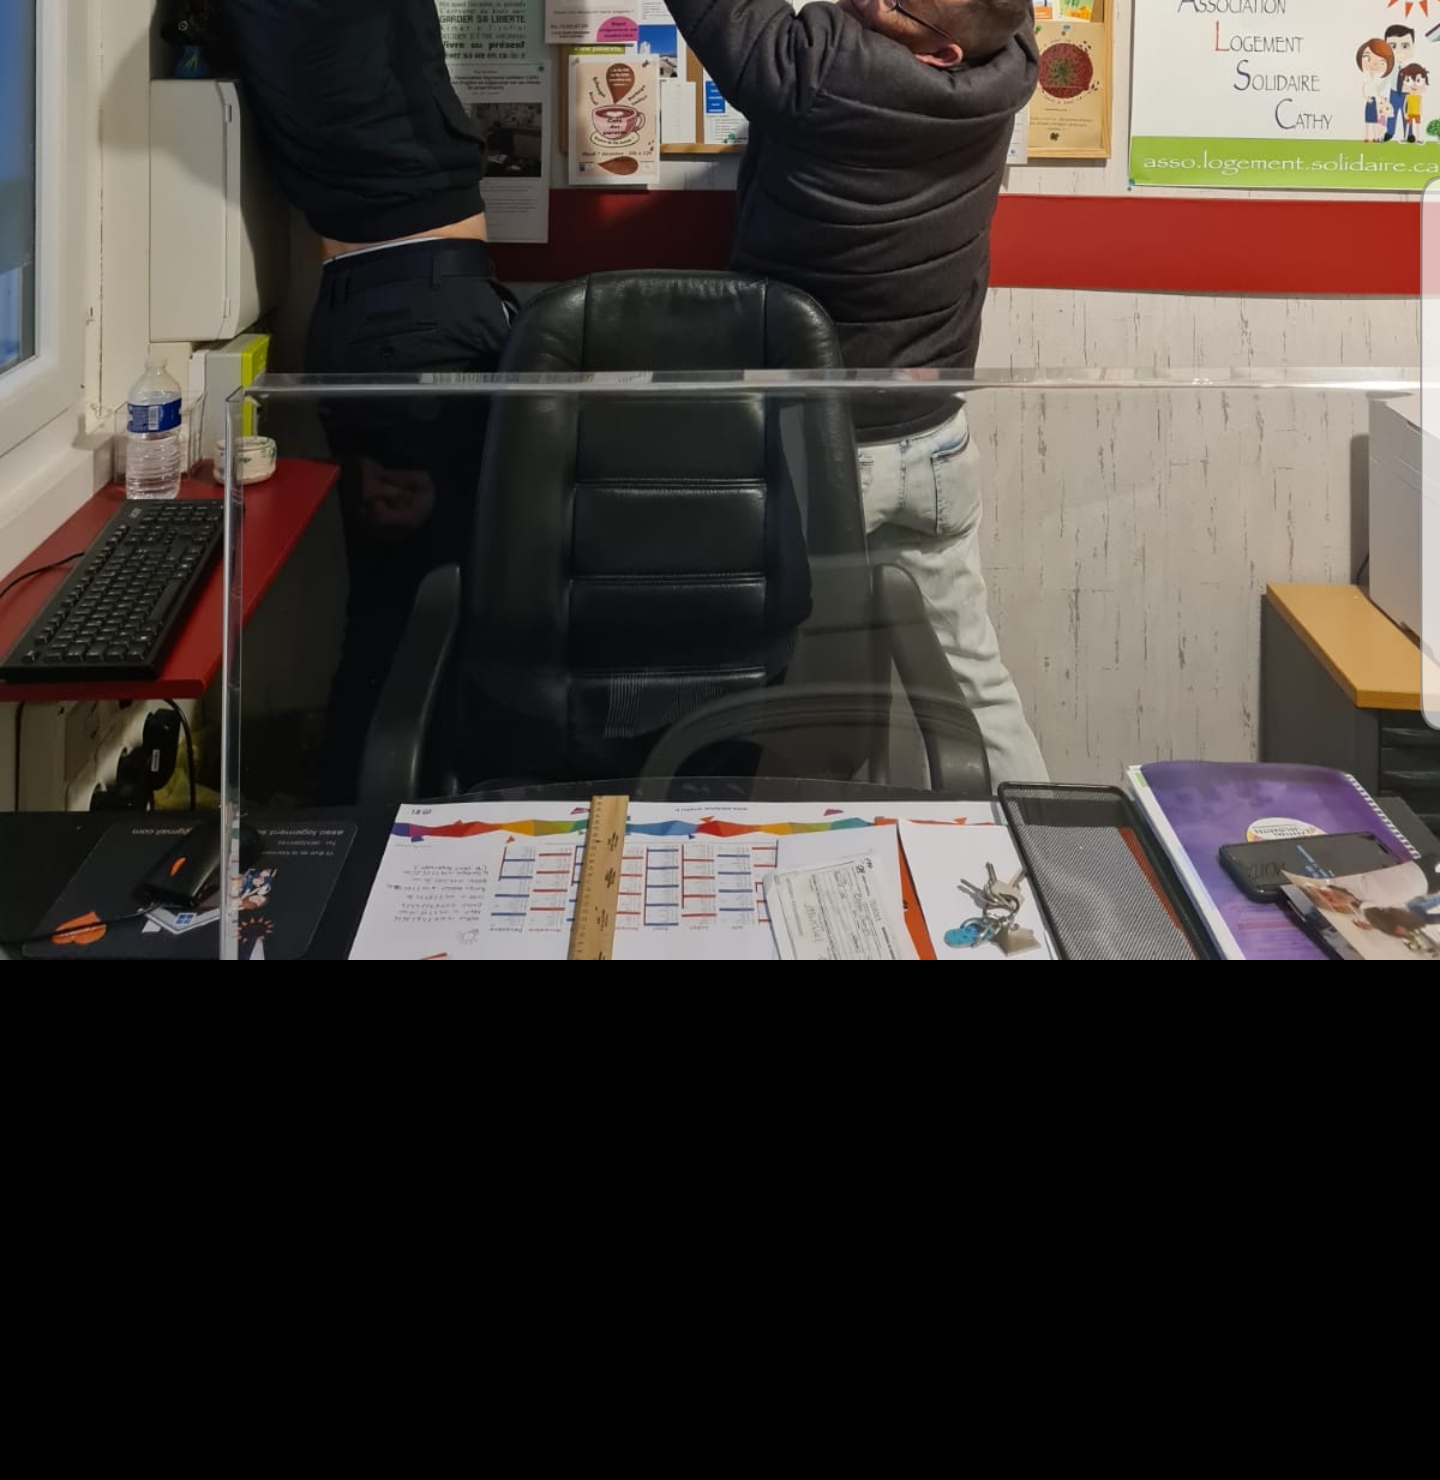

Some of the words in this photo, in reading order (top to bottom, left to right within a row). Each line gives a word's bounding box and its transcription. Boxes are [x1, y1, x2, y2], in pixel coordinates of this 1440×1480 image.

[1215, 21, 1304, 53] LOGEMENT
[1233, 60, 1320, 91] SOLIDAIRE
[1274, 98, 1333, 130] CATHY
